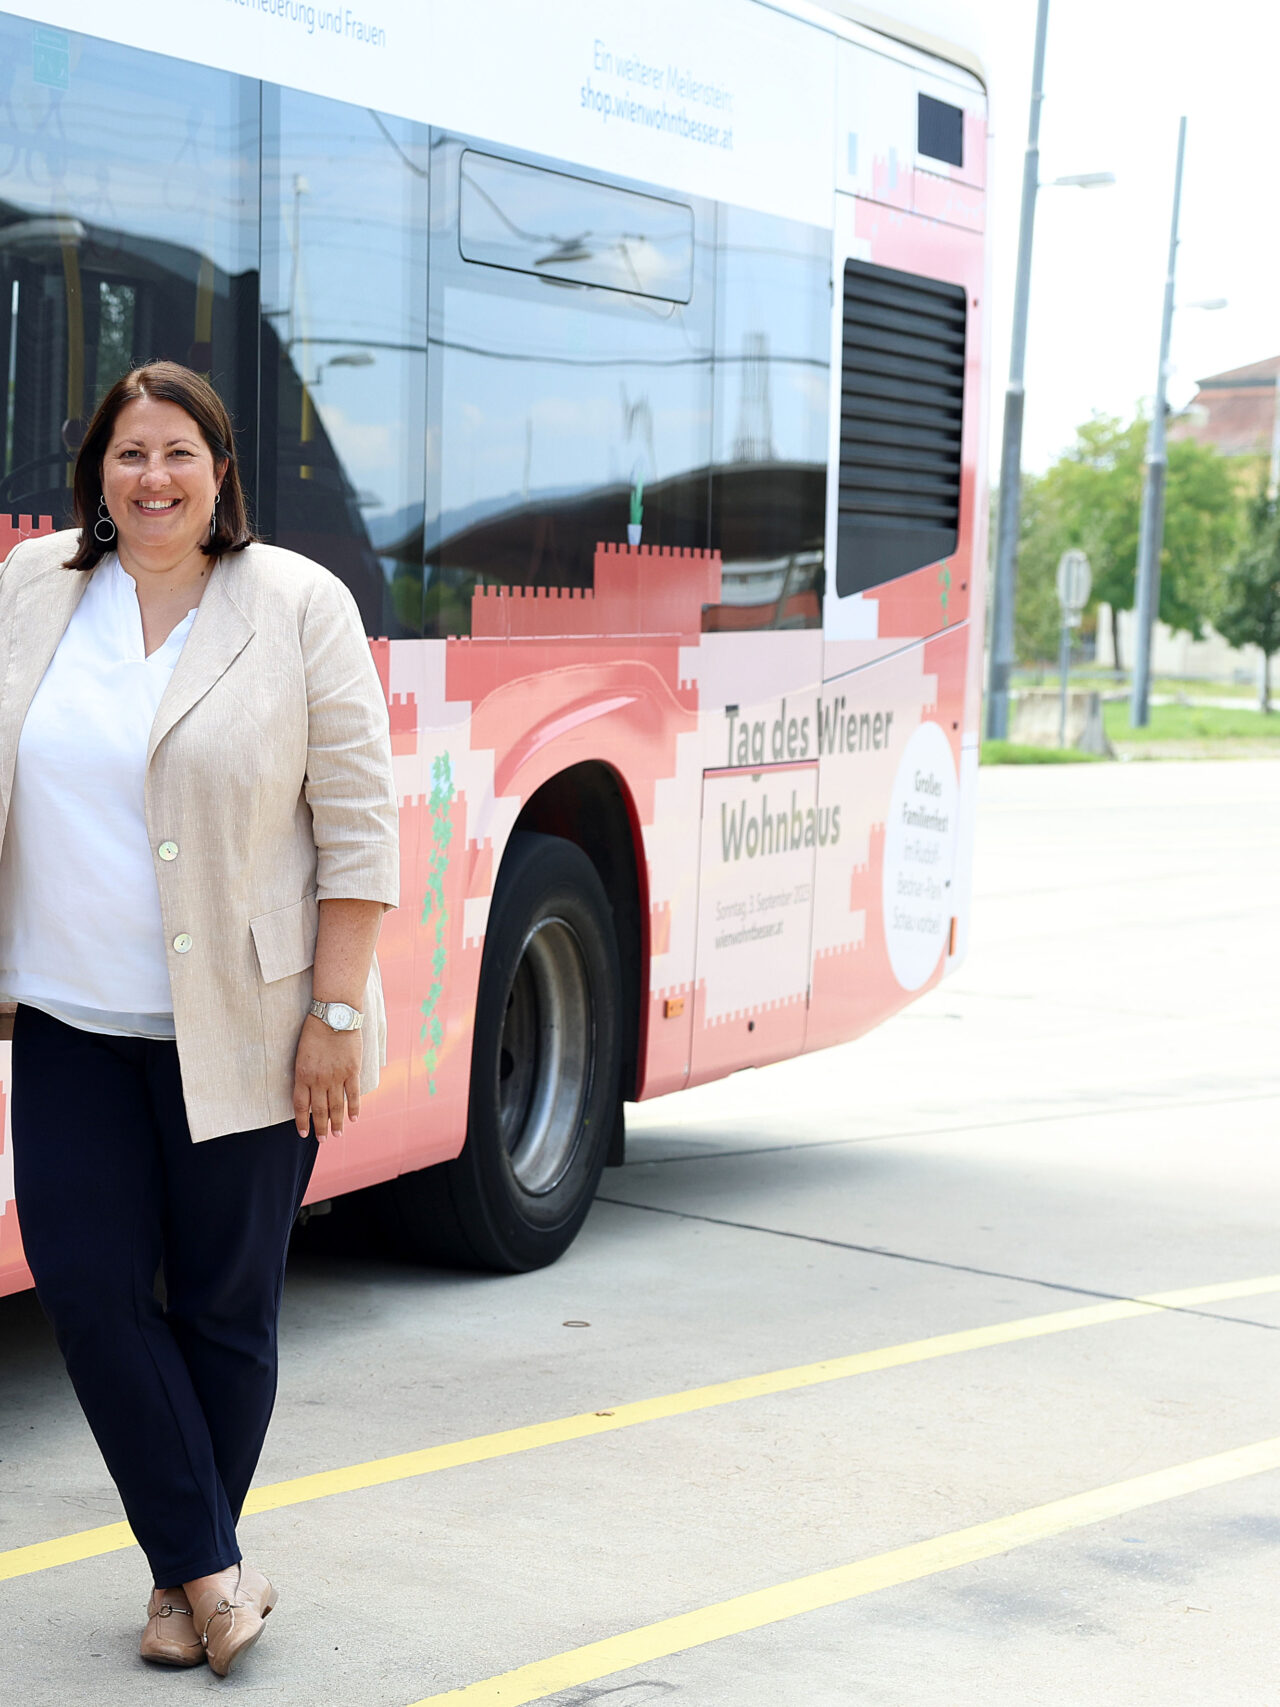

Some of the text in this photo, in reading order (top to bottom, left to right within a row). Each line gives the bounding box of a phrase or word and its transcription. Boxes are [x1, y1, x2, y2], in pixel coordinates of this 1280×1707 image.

[317, 6, 342, 34] und
[345, 10, 387, 47] Frauen
[593, 38, 613, 75] Ein
[615, 52, 664, 90] weiterer
[580, 76, 734, 151] shop.wienwohntbesser.at
[725, 695, 894, 783] Tag des Wiener
[721, 789, 841, 863] Wohnbaus
